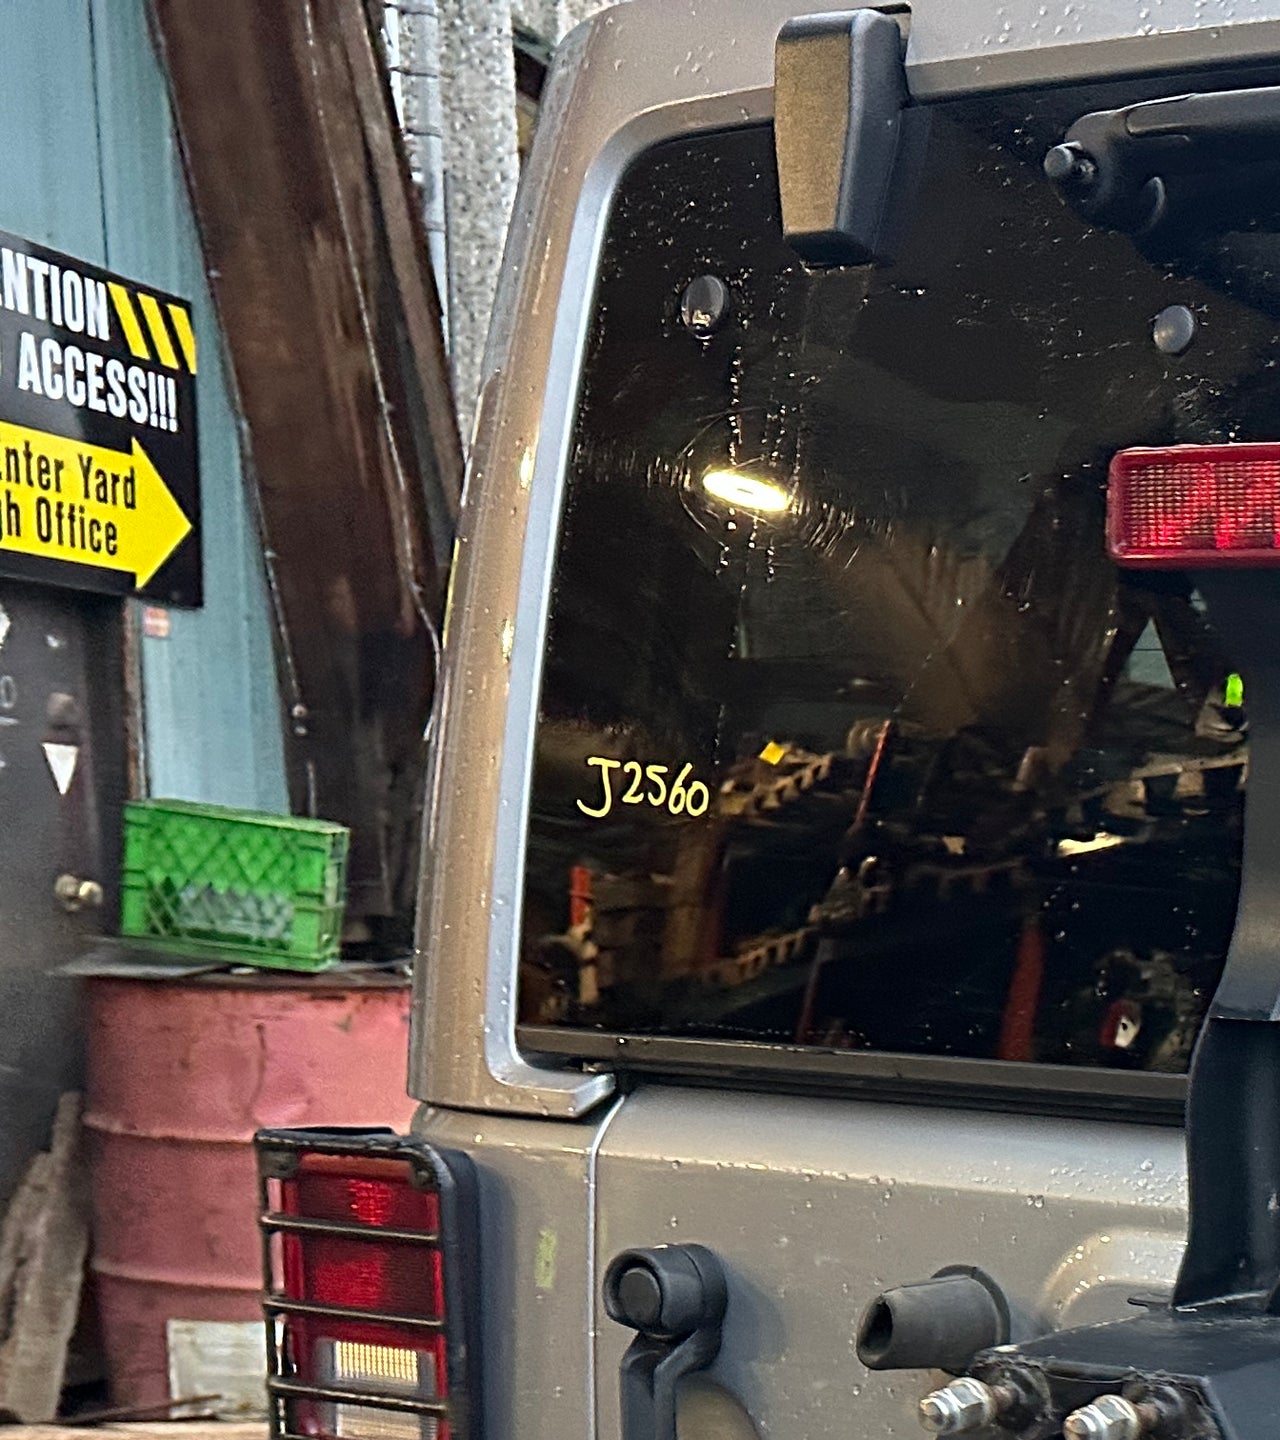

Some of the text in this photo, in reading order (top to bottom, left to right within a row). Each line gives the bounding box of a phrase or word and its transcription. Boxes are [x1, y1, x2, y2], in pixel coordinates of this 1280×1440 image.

[0, 247, 110, 342] NTION
[18, 331, 179, 433] ACCESS!!!
[0, 440, 137, 510] nter Yard
[0, 489, 118, 556] h Office
[576, 757, 710, 818] J2560
